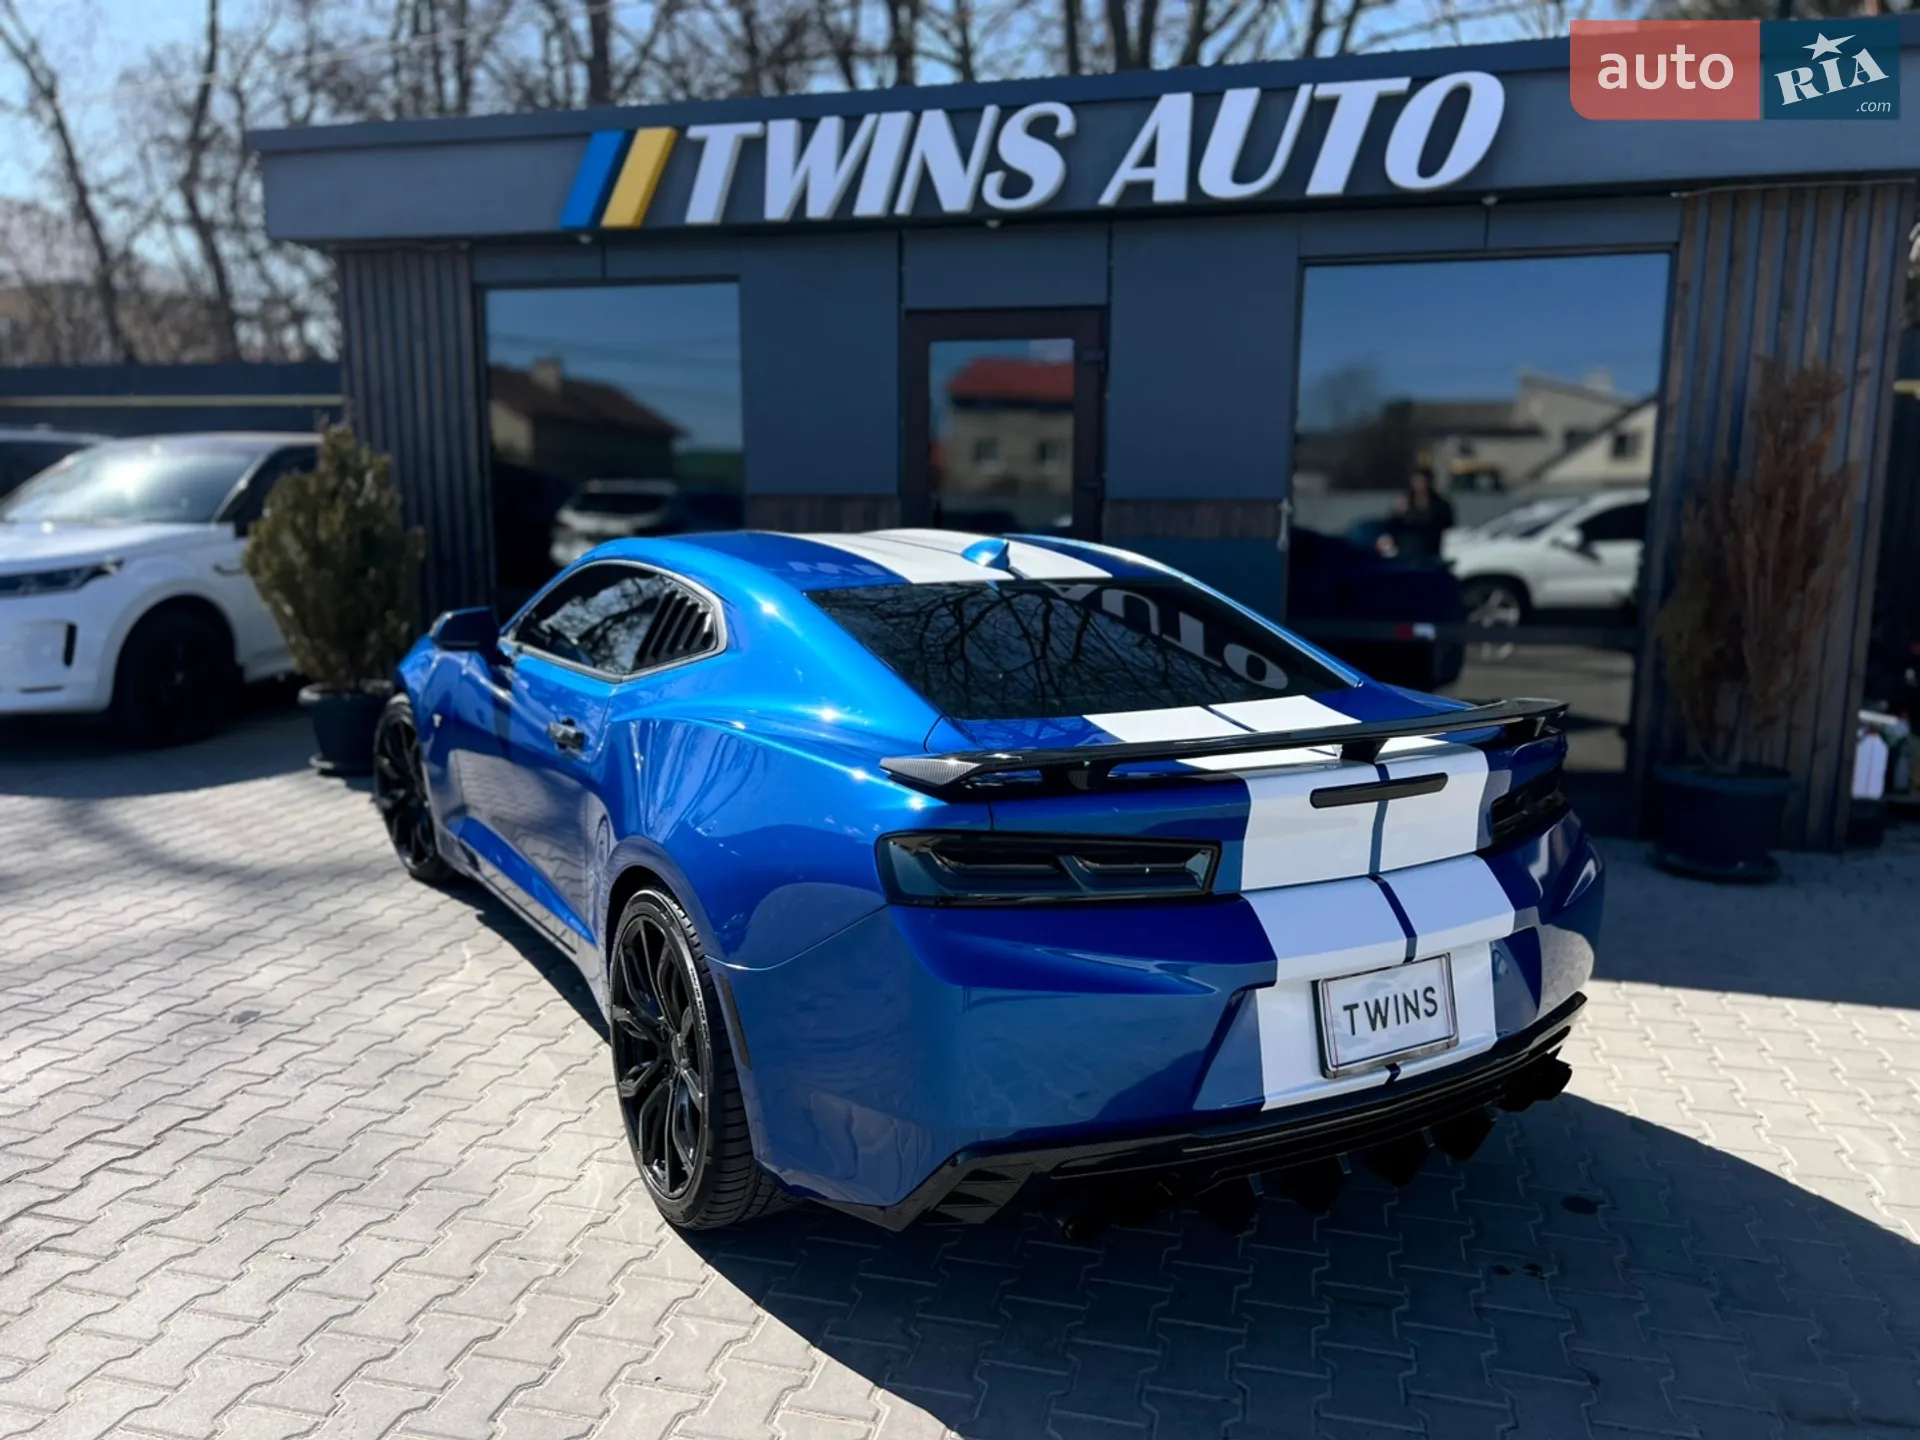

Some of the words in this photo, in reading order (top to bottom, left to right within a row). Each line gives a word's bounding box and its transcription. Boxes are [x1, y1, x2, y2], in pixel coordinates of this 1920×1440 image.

[685, 101, 1077, 226] TWINS
[1098, 70, 1506, 206] AUTO
[1343, 985, 1439, 1037] TWINS
